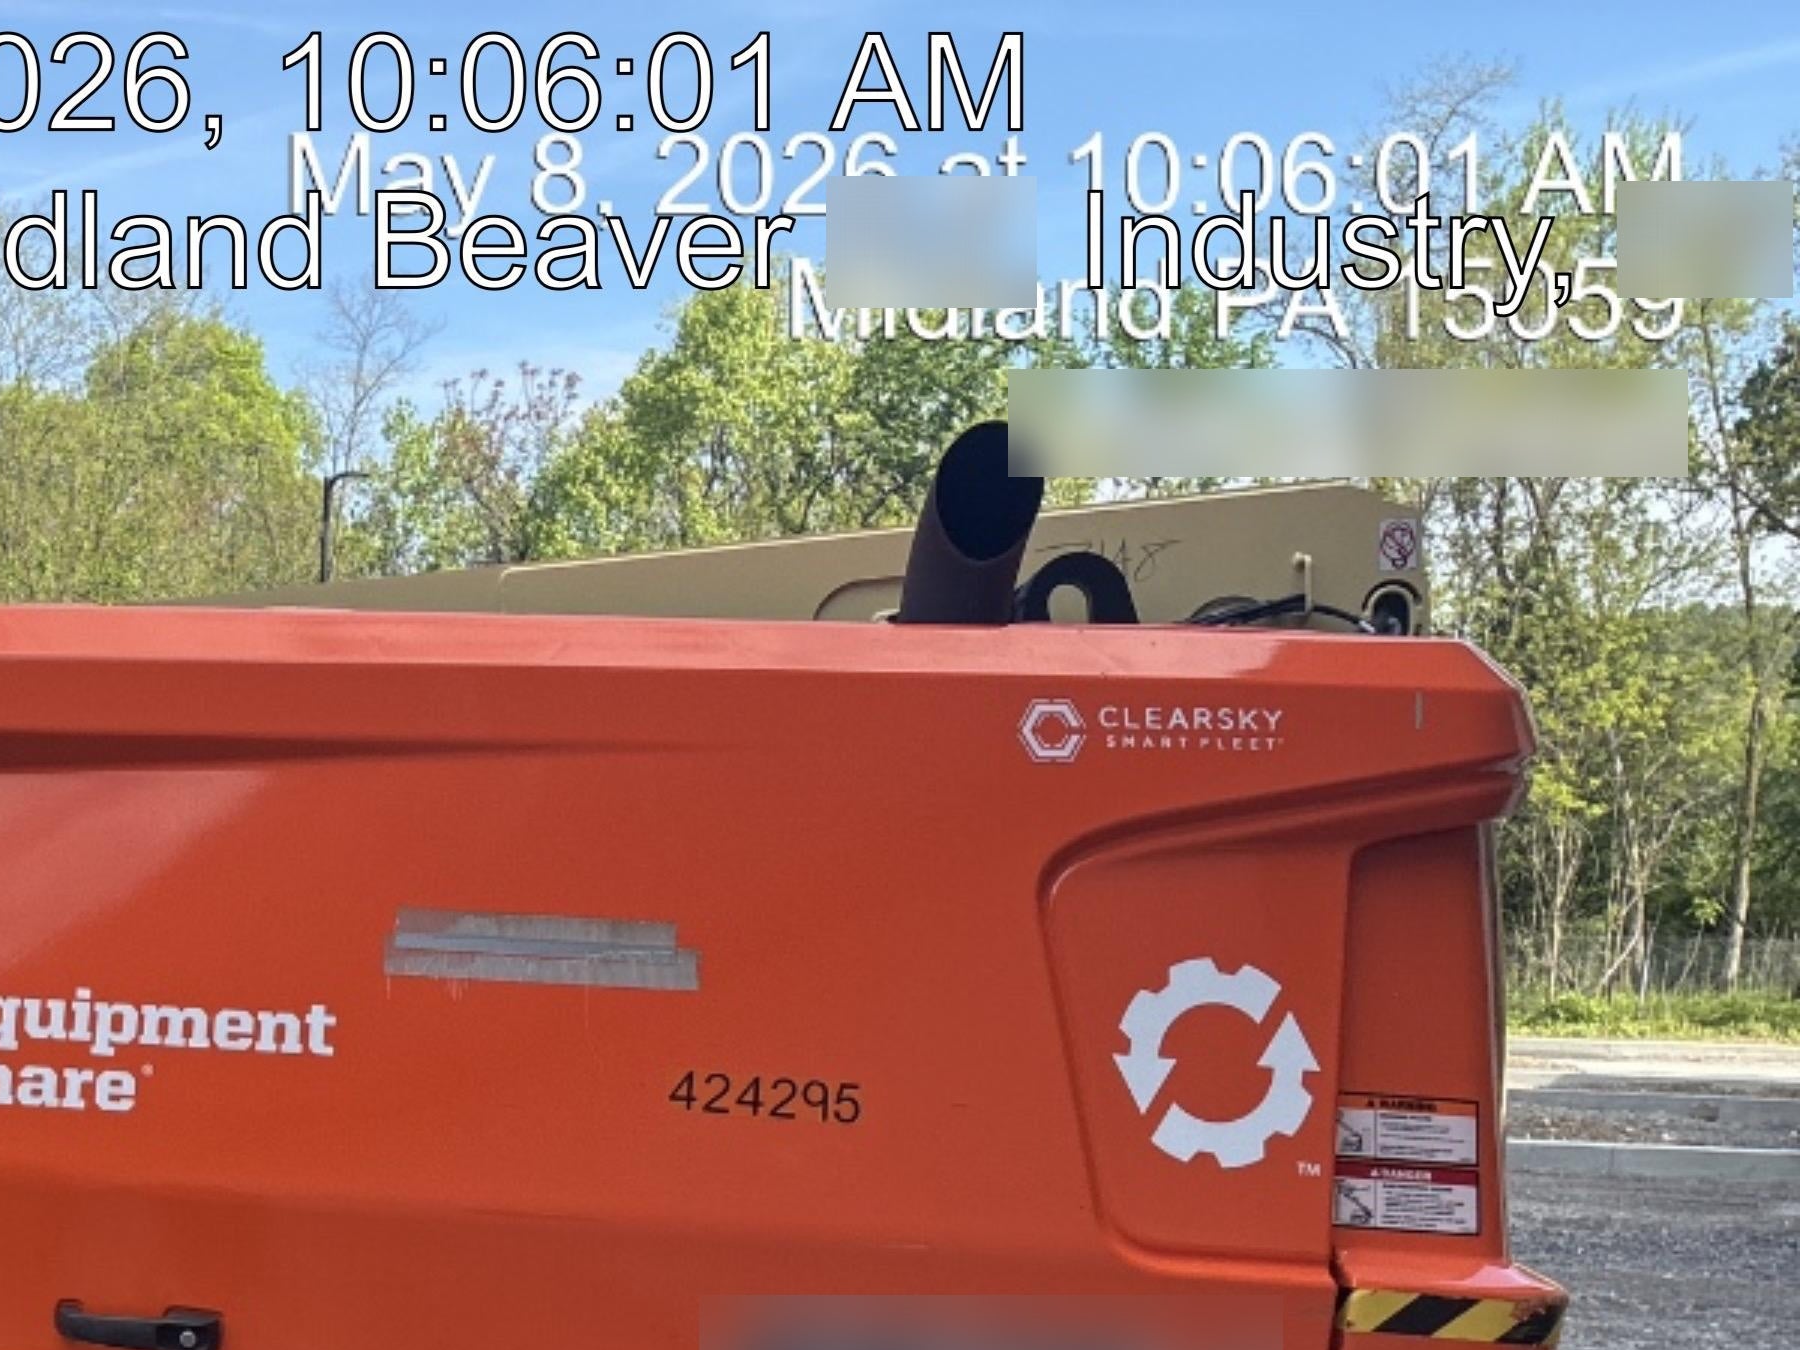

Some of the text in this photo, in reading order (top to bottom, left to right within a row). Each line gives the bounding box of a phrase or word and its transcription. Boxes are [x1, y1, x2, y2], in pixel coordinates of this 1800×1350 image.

[1097, 706, 1283, 732] CLEARSKY
[1105, 734, 1189, 750] SMART
[668, 1070, 862, 1124] 424295
